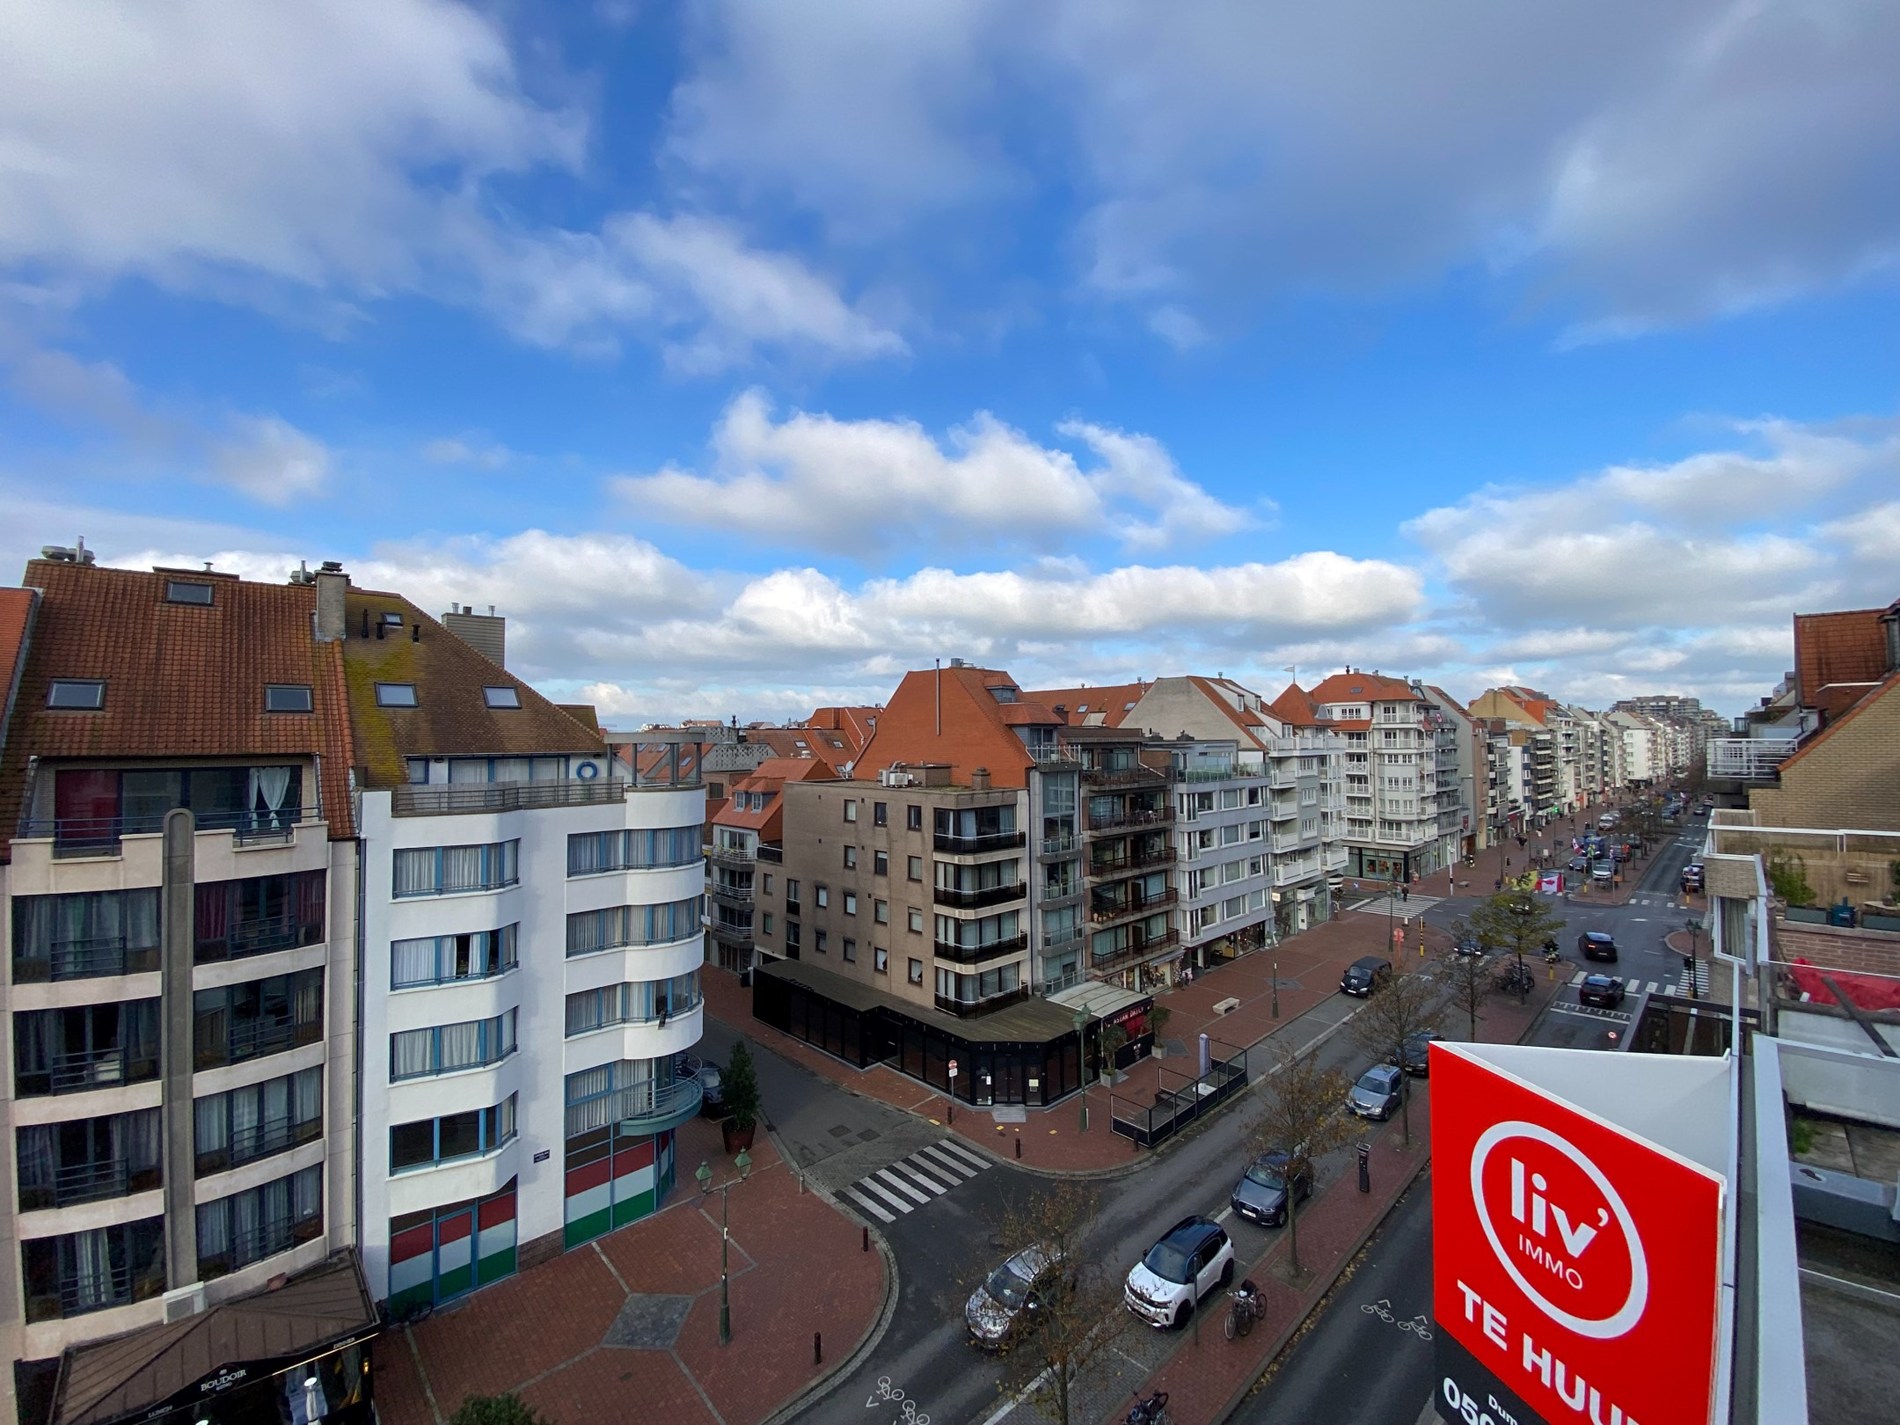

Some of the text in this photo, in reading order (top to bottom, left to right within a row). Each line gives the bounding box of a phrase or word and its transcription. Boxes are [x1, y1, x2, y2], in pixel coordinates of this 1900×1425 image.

[1518, 1233, 1584, 1290] IMMO
[200, 1369, 247, 1391] BOUDOIR
[1456, 1278, 1642, 1425] TE HUU
